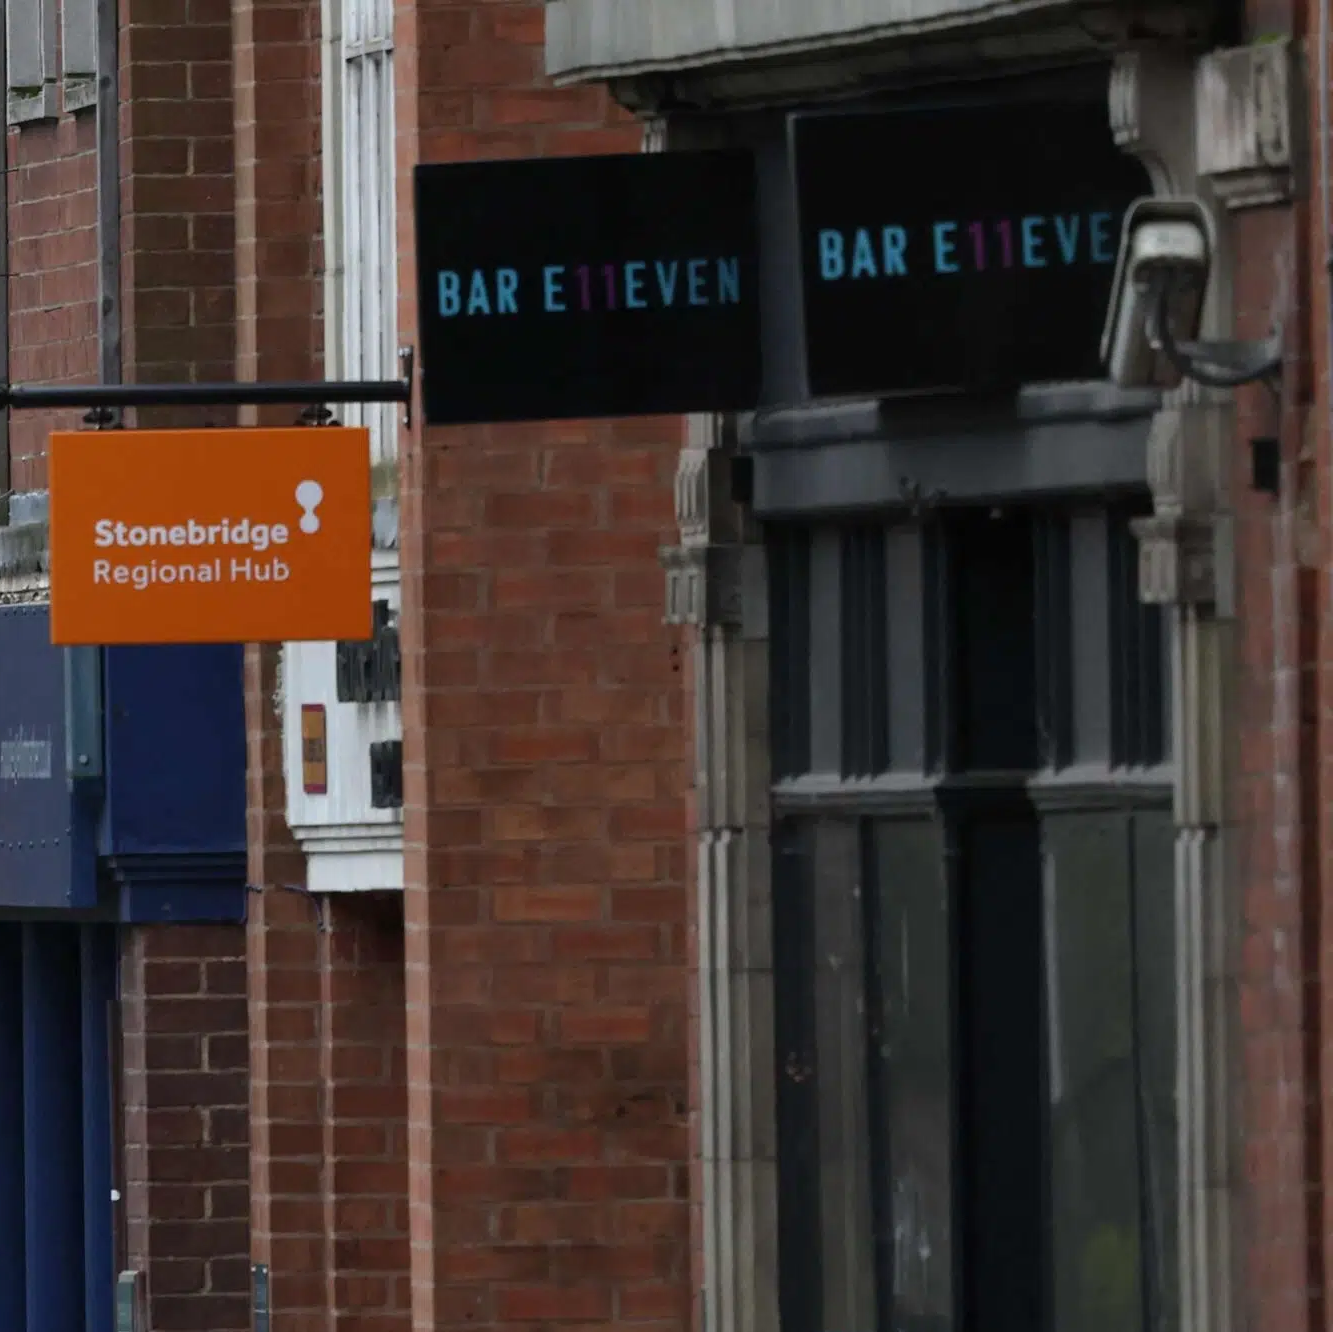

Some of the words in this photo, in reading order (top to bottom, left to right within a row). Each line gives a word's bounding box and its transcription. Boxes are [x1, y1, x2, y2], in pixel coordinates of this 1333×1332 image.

[818, 224, 907, 281] BAR
[932, 211, 1115, 274] E11EVE
[437, 267, 520, 318] BAR
[543, 256, 740, 313] E11EVEN
[94, 519, 289, 550] Stonebridge
[93, 559, 221, 590] Regional
[230, 558, 290, 582] Hub
